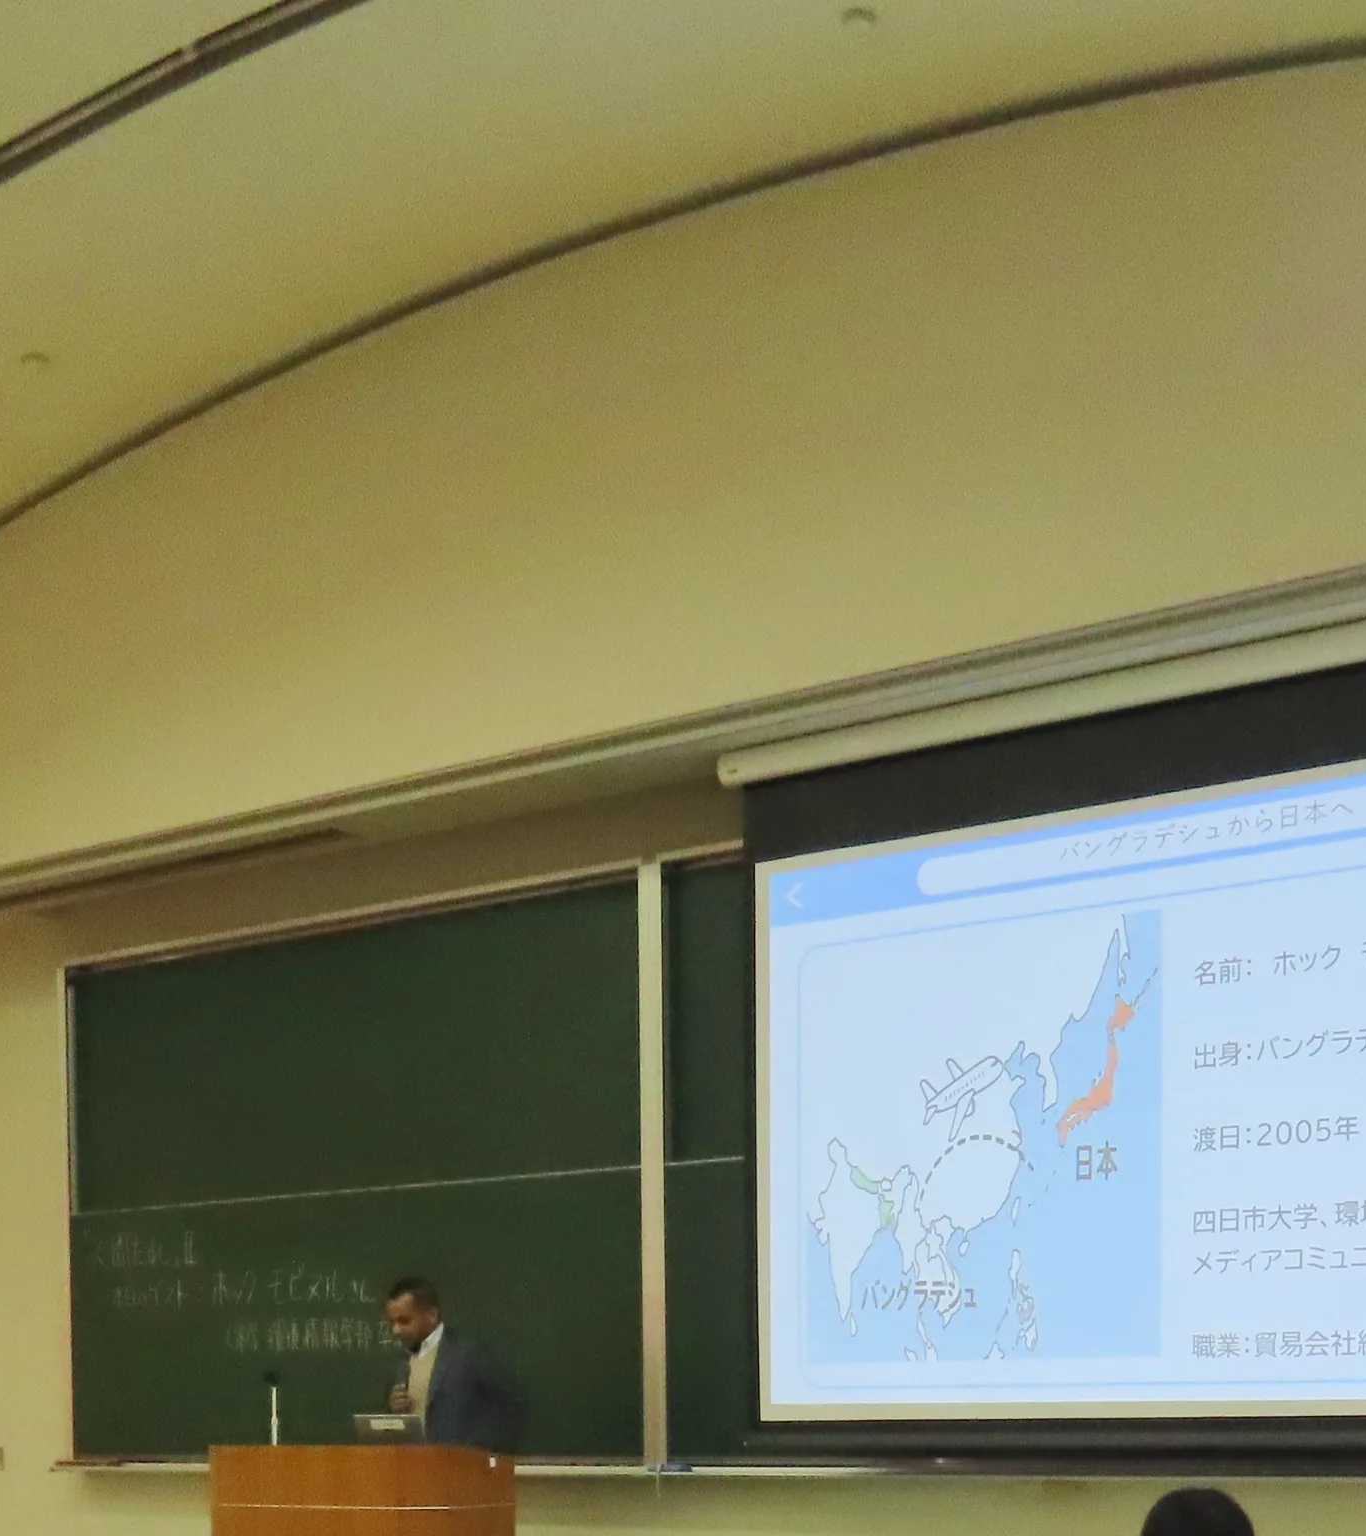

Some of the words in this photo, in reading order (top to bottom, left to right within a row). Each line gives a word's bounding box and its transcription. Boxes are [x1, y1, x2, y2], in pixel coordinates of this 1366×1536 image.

[1059, 800, 1355, 861] バングラデシュから日本へ
[1273, 944, 1341, 977] ホック
[1076, 1140, 1118, 1181] 日本
[861, 1278, 977, 1312] バングラデシュ
